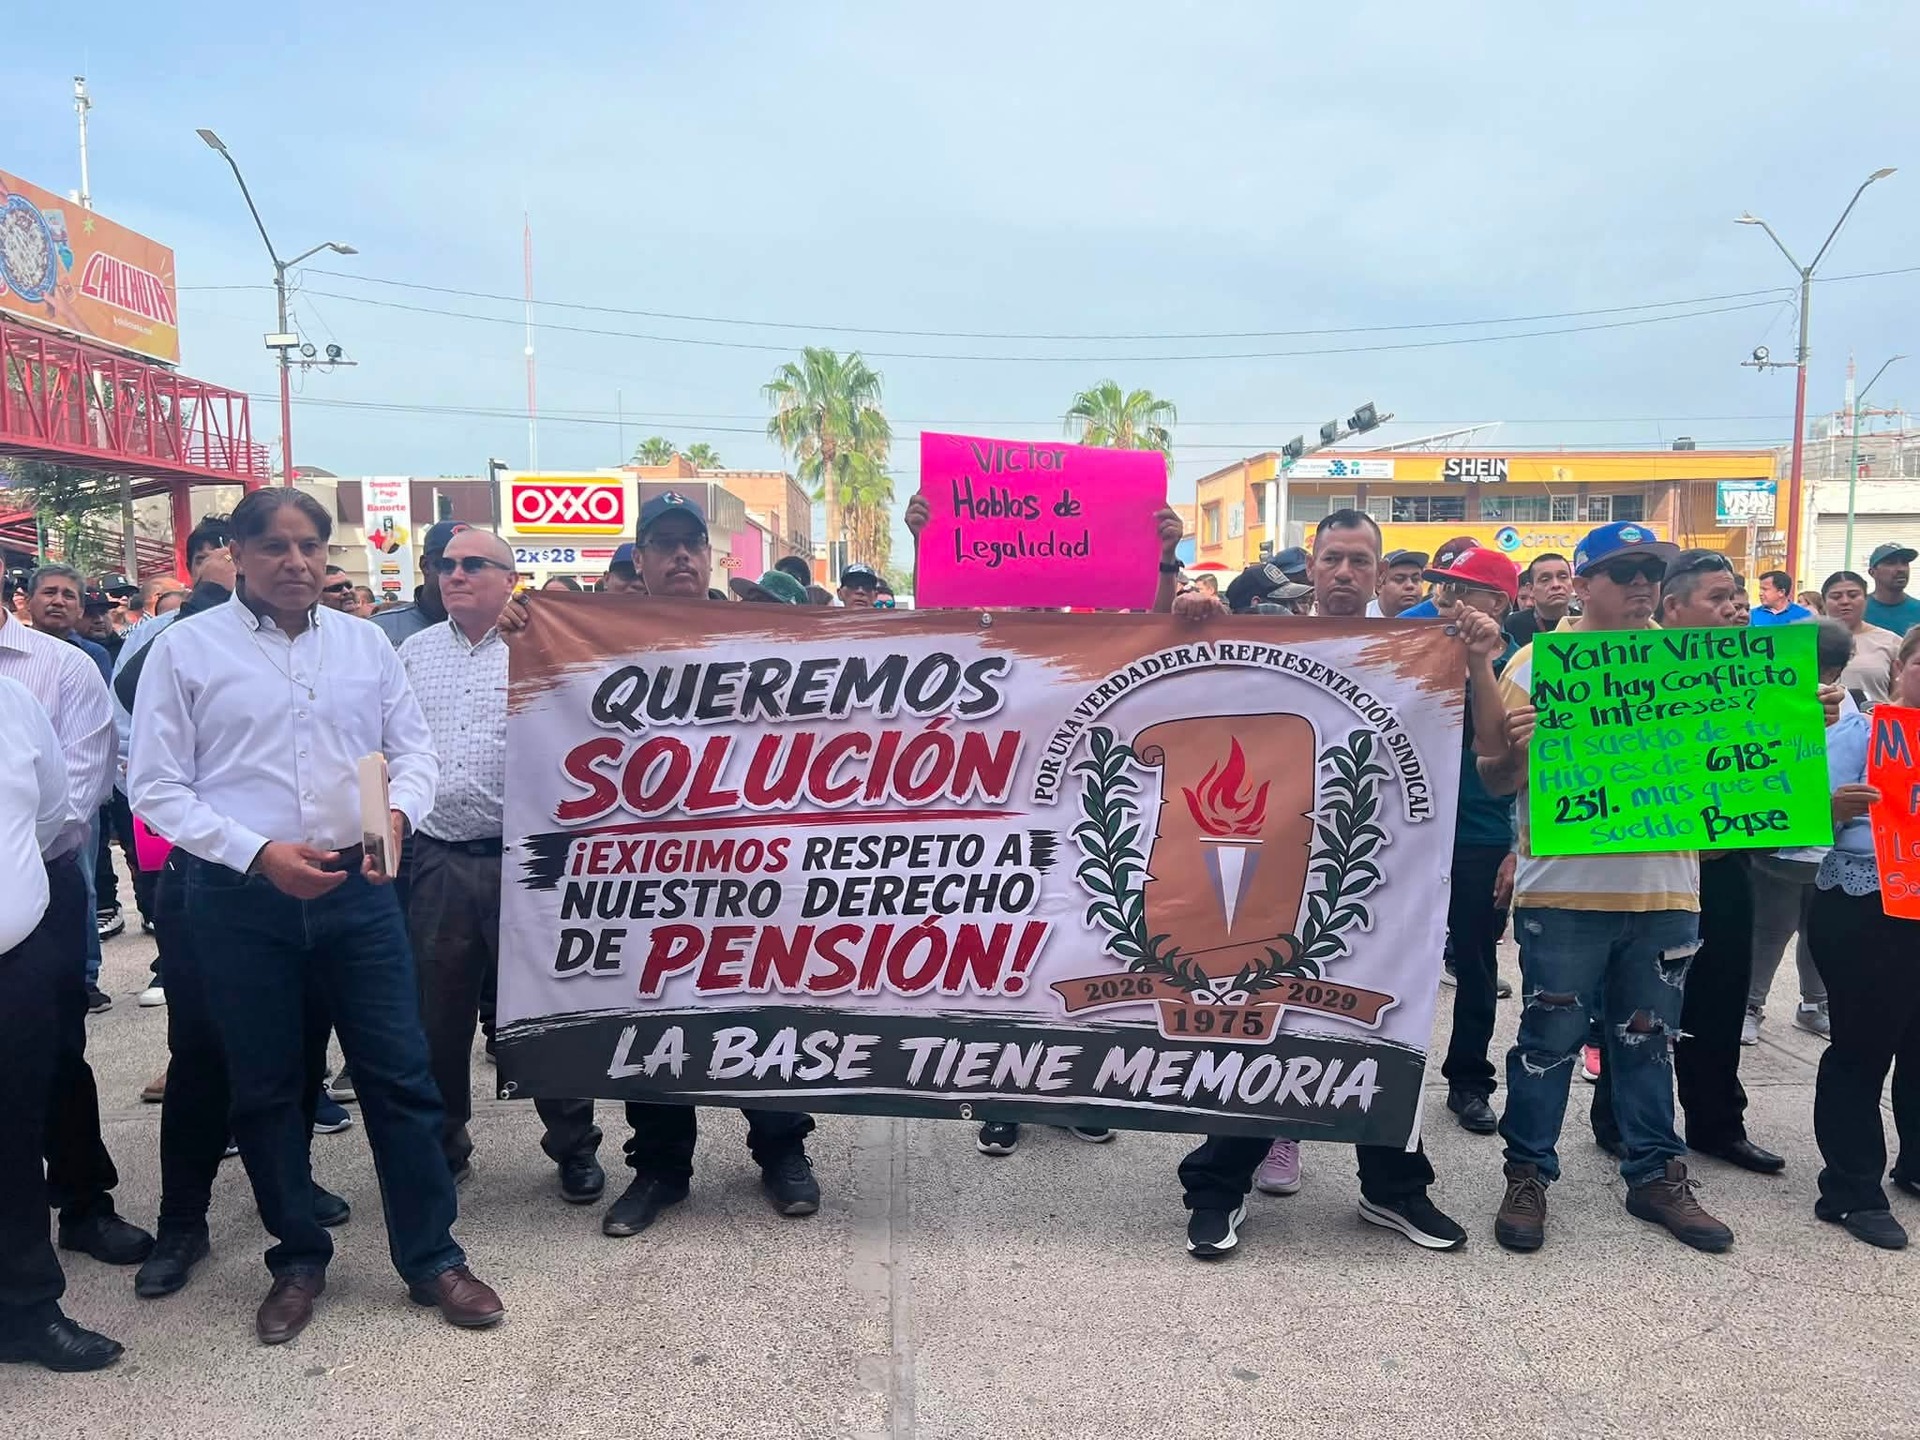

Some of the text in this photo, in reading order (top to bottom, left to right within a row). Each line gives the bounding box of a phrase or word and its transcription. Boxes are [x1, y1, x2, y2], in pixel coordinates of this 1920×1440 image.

[81, 251, 176, 327] CHILCHOTA
[1446, 458, 1507, 475] SHEIN
[515, 486, 619, 523] OXXO
[952, 475, 1081, 521] Hablas de
[955, 526, 1089, 568] Legalidad
[1547, 629, 1775, 674] Yahir Vitela
[592, 652, 1007, 731] QUEREMOS
[1603, 672, 1656, 706] hay
[1034, 644, 1430, 819] POR UNA VERDADERA REPRESENTACIÓN SINDICAL
[1538, 707, 1576, 731] de
[1538, 734, 1575, 762] el
[1695, 718, 1731, 743] de
[1742, 720, 1781, 740] tu
[555, 716, 1021, 819] SOLUCIÓN
[1538, 763, 1603, 794] Hijo
[1610, 761, 1649, 783] es
[1702, 776, 1756, 808] que
[1762, 770, 1793, 795] el
[1699, 805, 1792, 843] Base
[571, 832, 1024, 876] ¡EXIGIMOS RESPETO A
[559, 872, 1034, 921] NUESTRO DERECHO
[554, 915, 1048, 995] DE PENSIÓN!
[1084, 977, 1358, 1010] 2026 2029
[1172, 1008, 1264, 1035] 1975
[606, 1024, 1384, 1113] LA BASE TIENE MEMORIA
